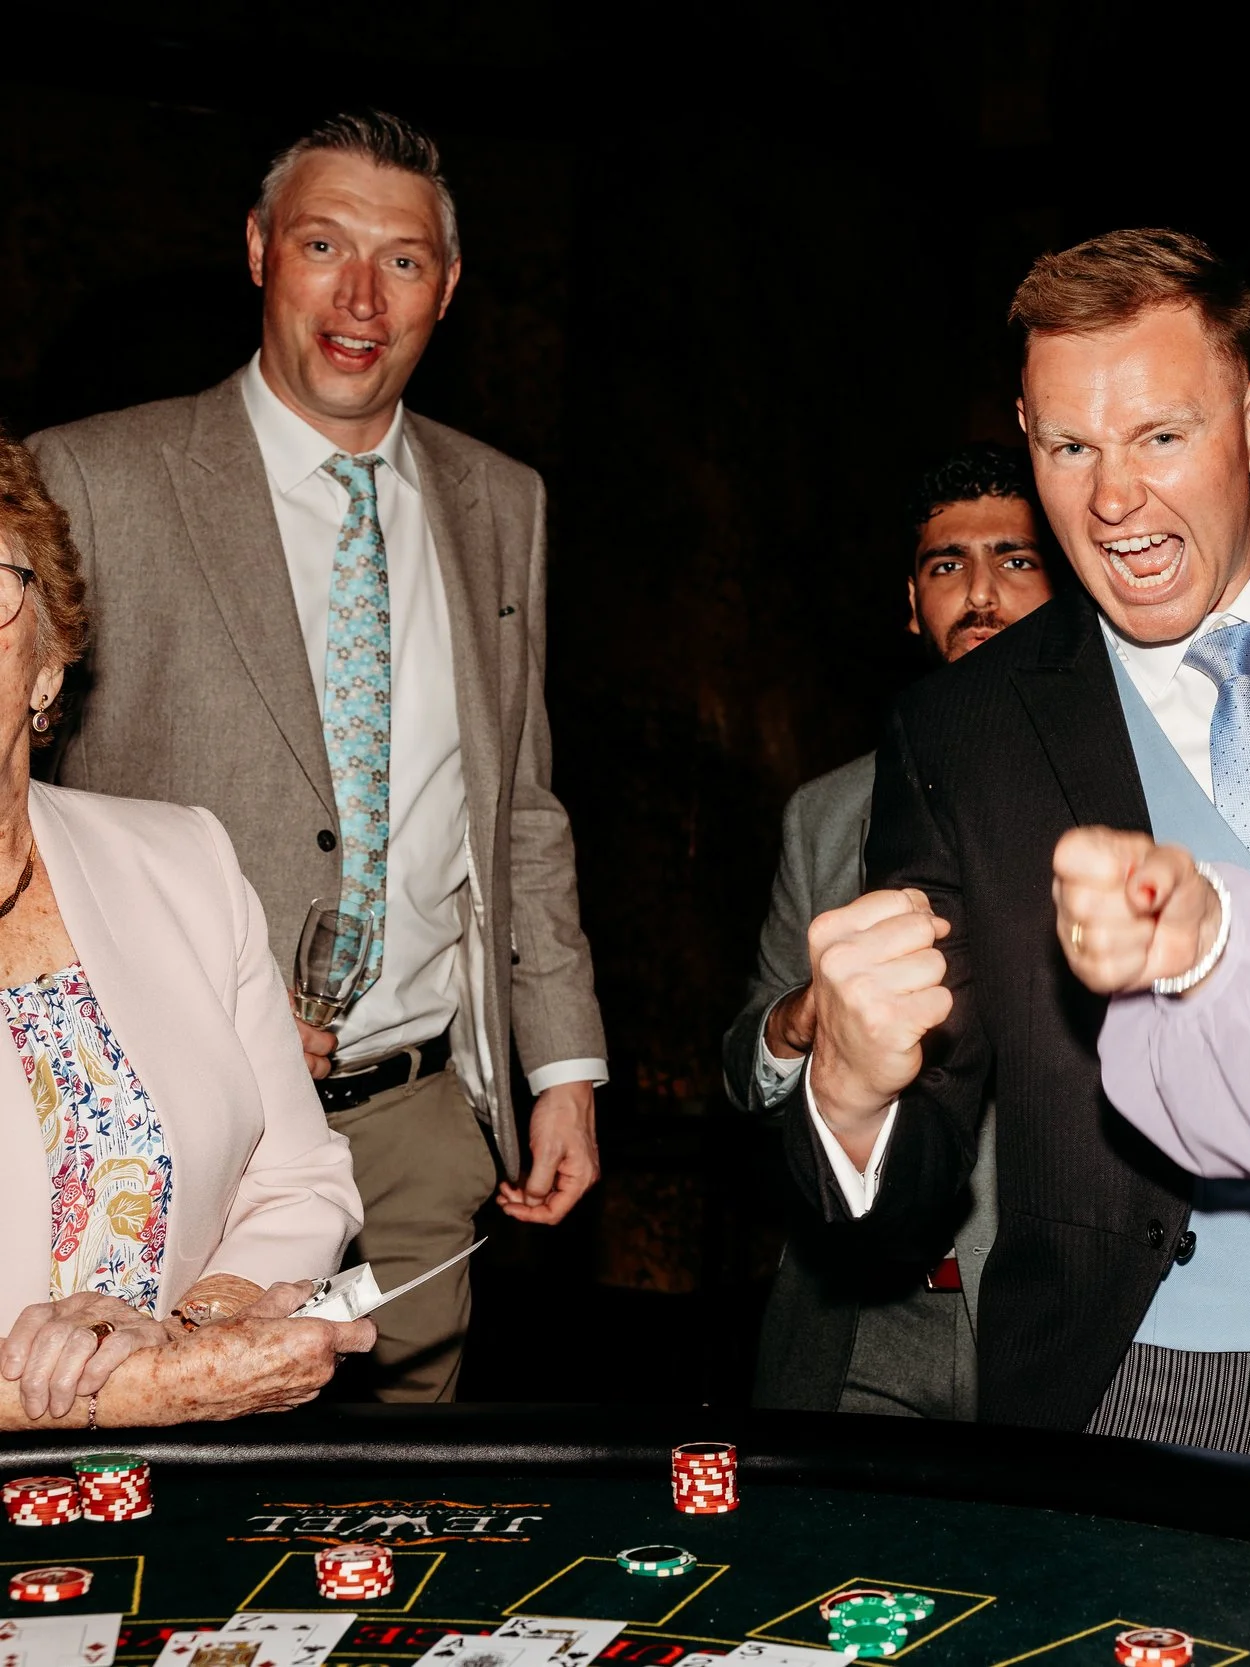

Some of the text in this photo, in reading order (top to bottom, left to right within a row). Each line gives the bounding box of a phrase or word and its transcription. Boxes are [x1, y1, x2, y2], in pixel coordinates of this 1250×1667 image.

[246, 1514, 543, 1536] JEWEL
[0, 1621, 17, 1631] A
[509, 1619, 538, 1629] K
[444, 1637, 464, 1648] A
